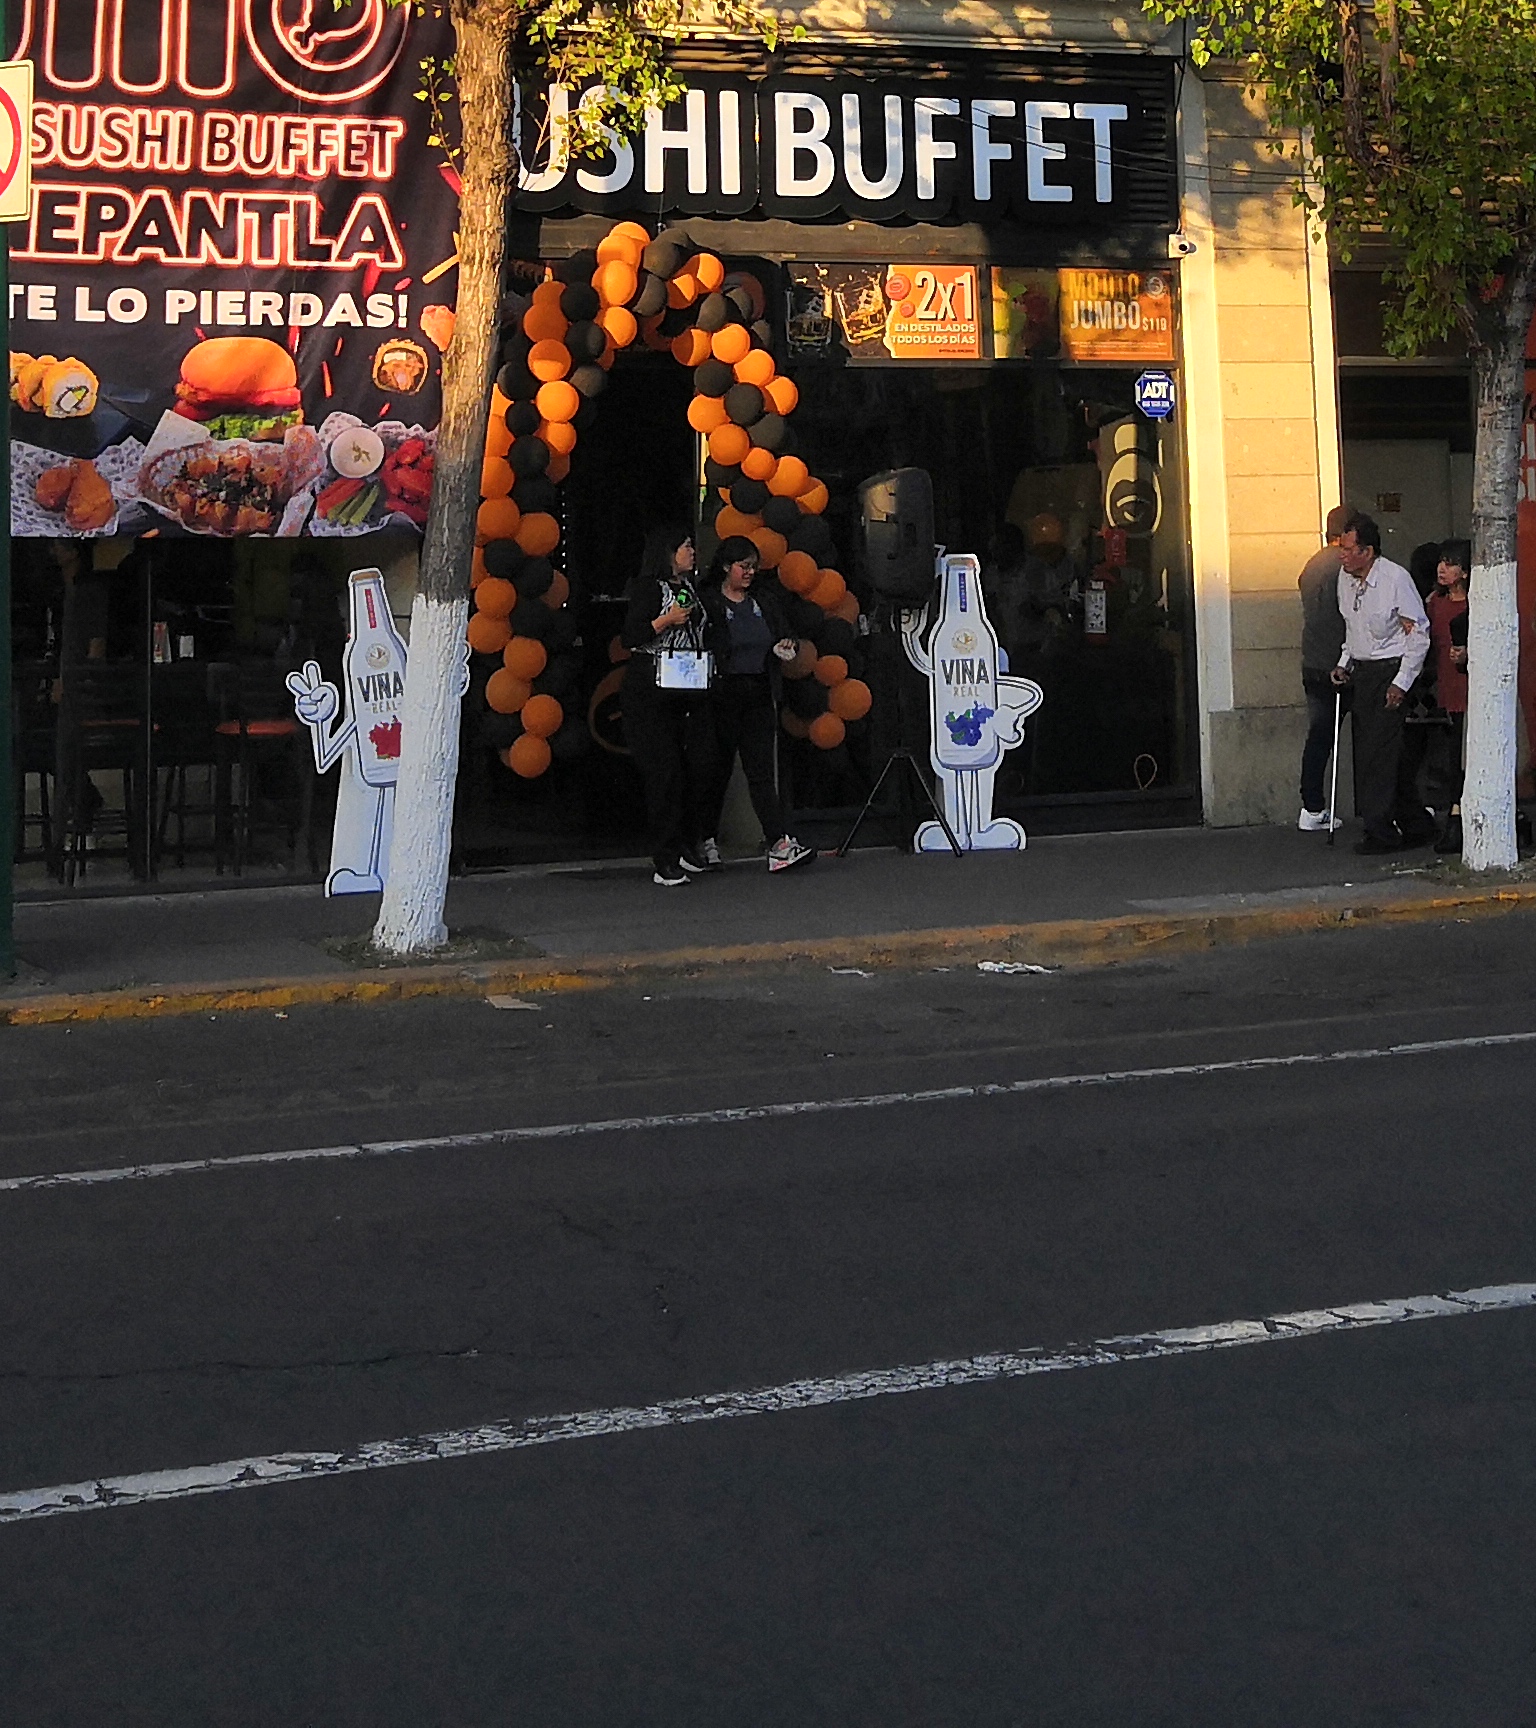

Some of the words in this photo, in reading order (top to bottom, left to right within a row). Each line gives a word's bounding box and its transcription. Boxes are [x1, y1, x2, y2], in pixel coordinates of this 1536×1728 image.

[31, 104, 194, 171] SUSHI
[201, 112, 405, 179] BUFFET
[512, 78, 741, 195] USHI
[774, 90, 1129, 204] BUFFET
[75, 286, 148, 324] LO
[165, 289, 408, 328] PIERDAS!
[915, 270, 974, 322] 2x1
[895, 323, 909, 332] EN
[910, 323, 975, 333] DESTILADOS
[1070, 300, 1141, 330] JUMBO
[891, 335, 927, 344] TODOS
[928, 335, 948, 344] LOS
[949, 333, 976, 344] DÍAS
[1142, 381, 1169, 399] ADT
[941, 658, 990, 686] VIÑA
[953, 686, 981, 698] REAL
